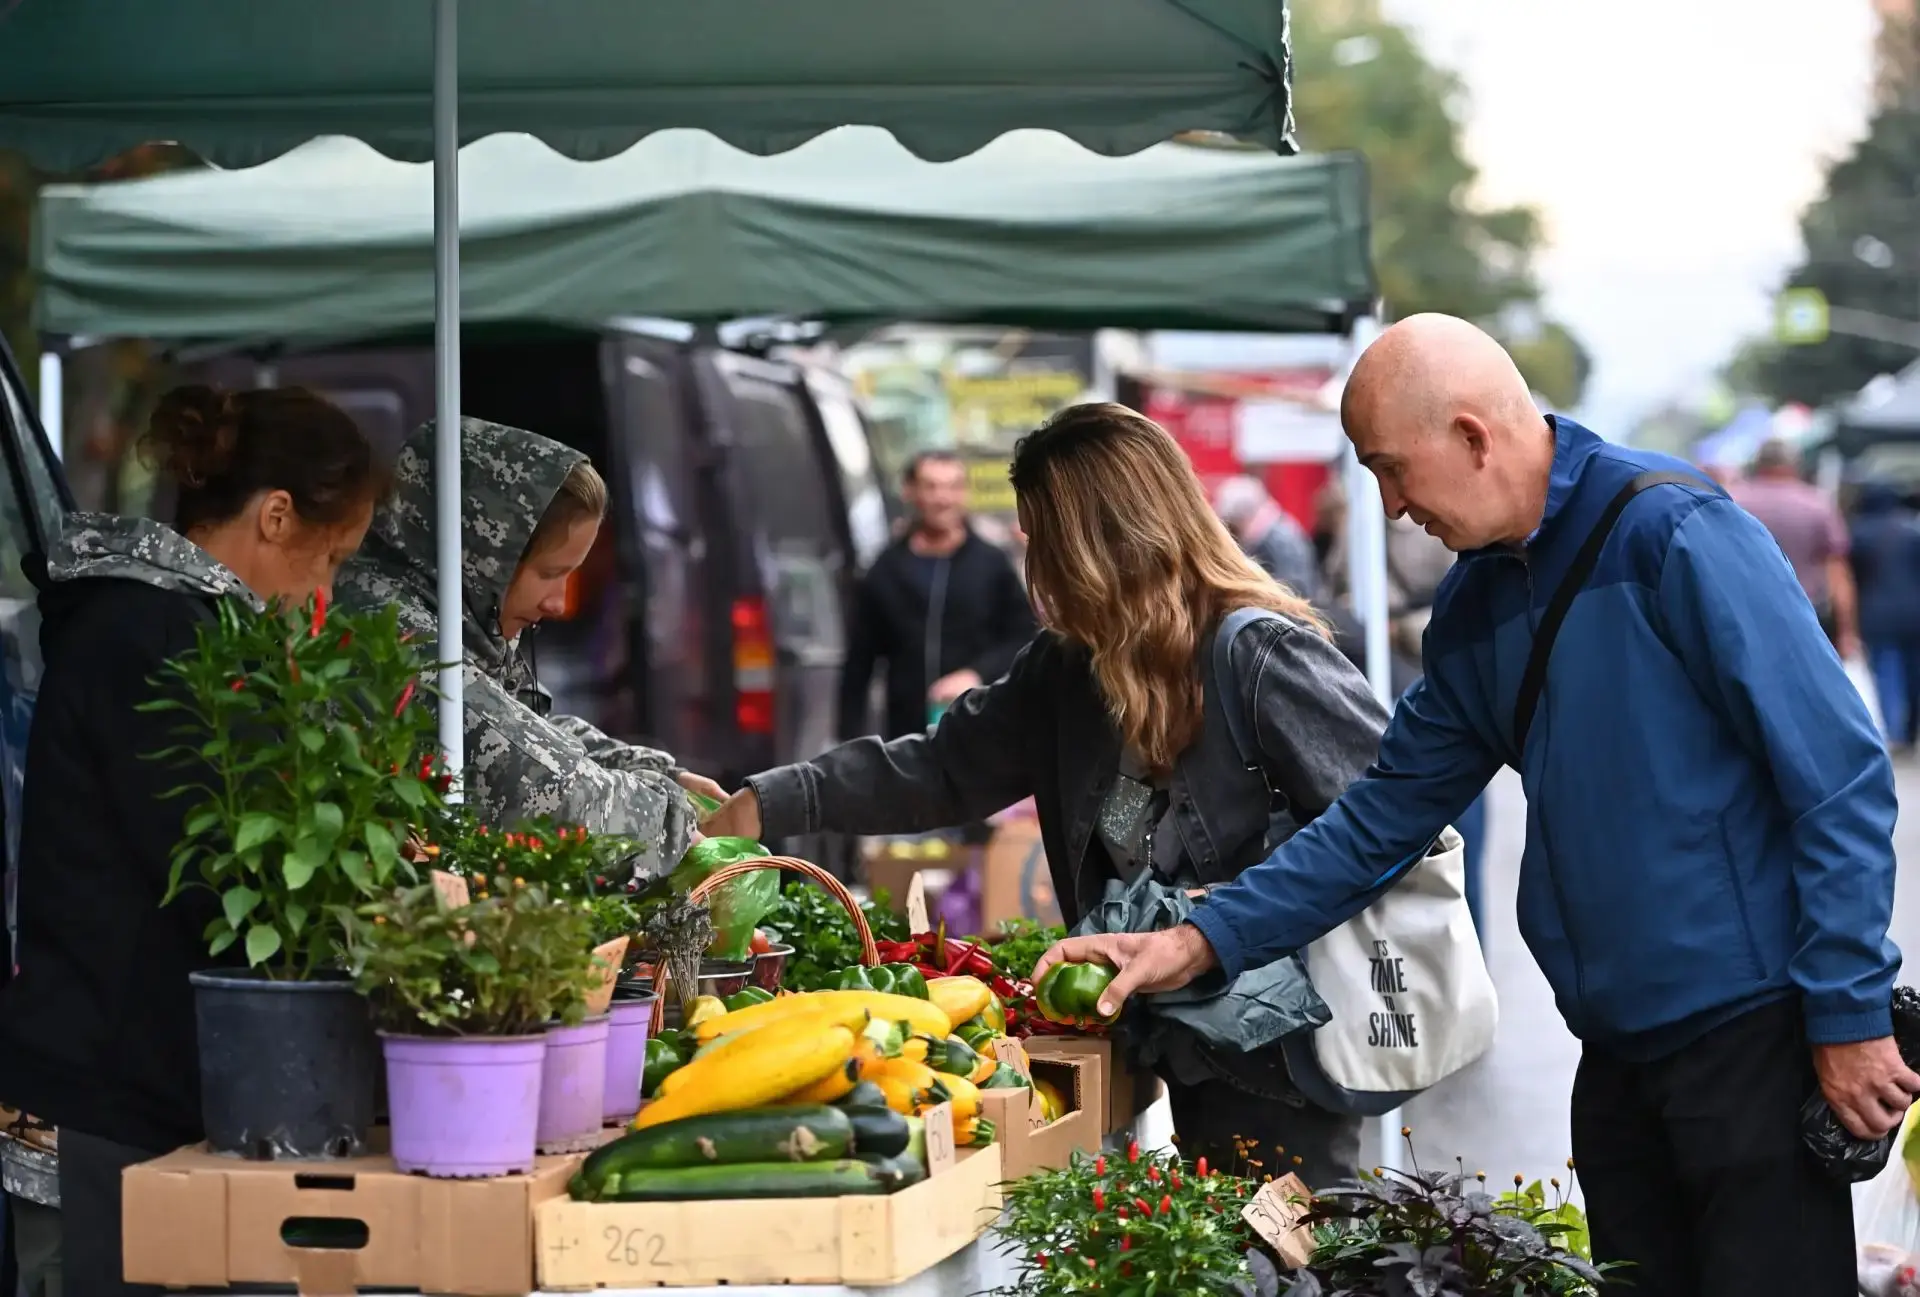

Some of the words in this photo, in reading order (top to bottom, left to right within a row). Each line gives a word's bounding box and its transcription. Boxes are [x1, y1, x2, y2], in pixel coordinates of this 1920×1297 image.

[1368, 958, 1407, 993] TIME
[1383, 995, 1395, 1012] TO
[1368, 1012, 1418, 1048] SHINE
[604, 1225, 673, 1266] 262
